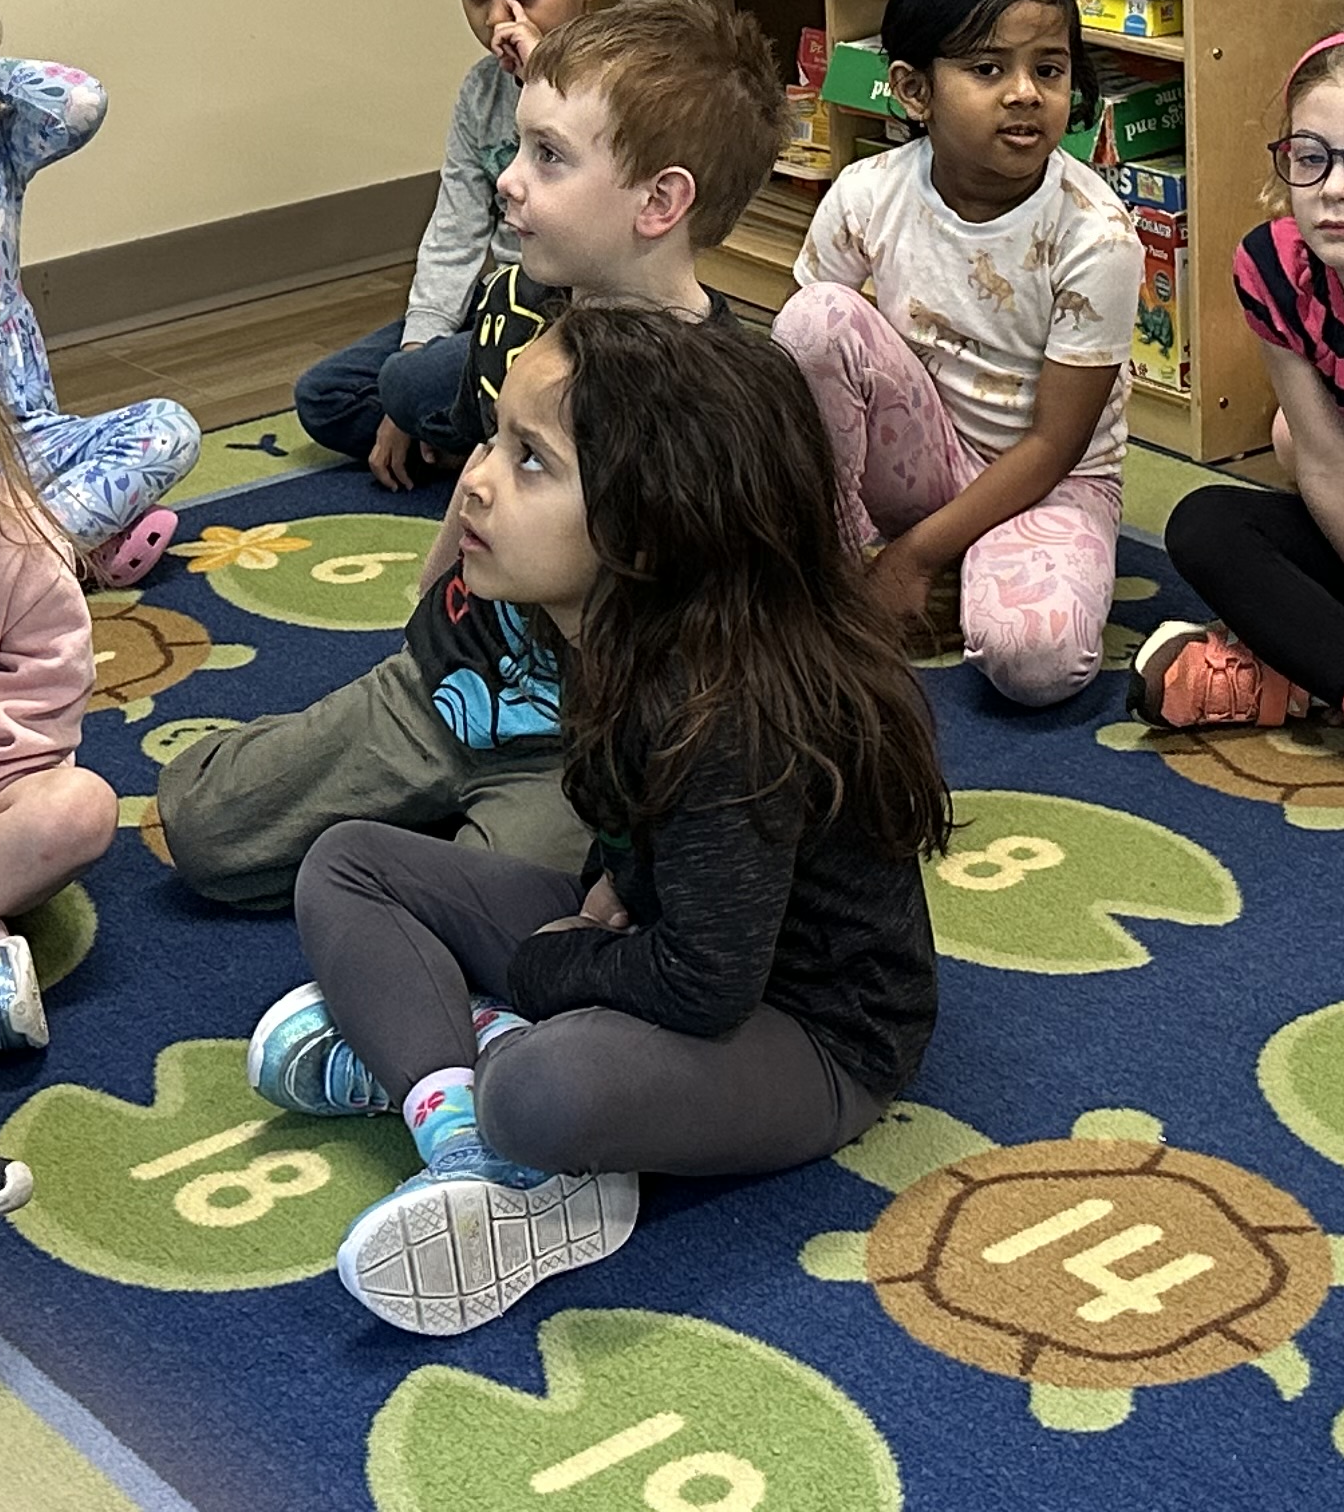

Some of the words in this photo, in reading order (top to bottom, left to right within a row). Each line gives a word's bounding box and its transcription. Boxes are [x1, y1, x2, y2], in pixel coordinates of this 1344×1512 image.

[935, 835, 1066, 892] 8
[130, 1116, 332, 1230] 18
[982, 1197, 1217, 1324] 14
